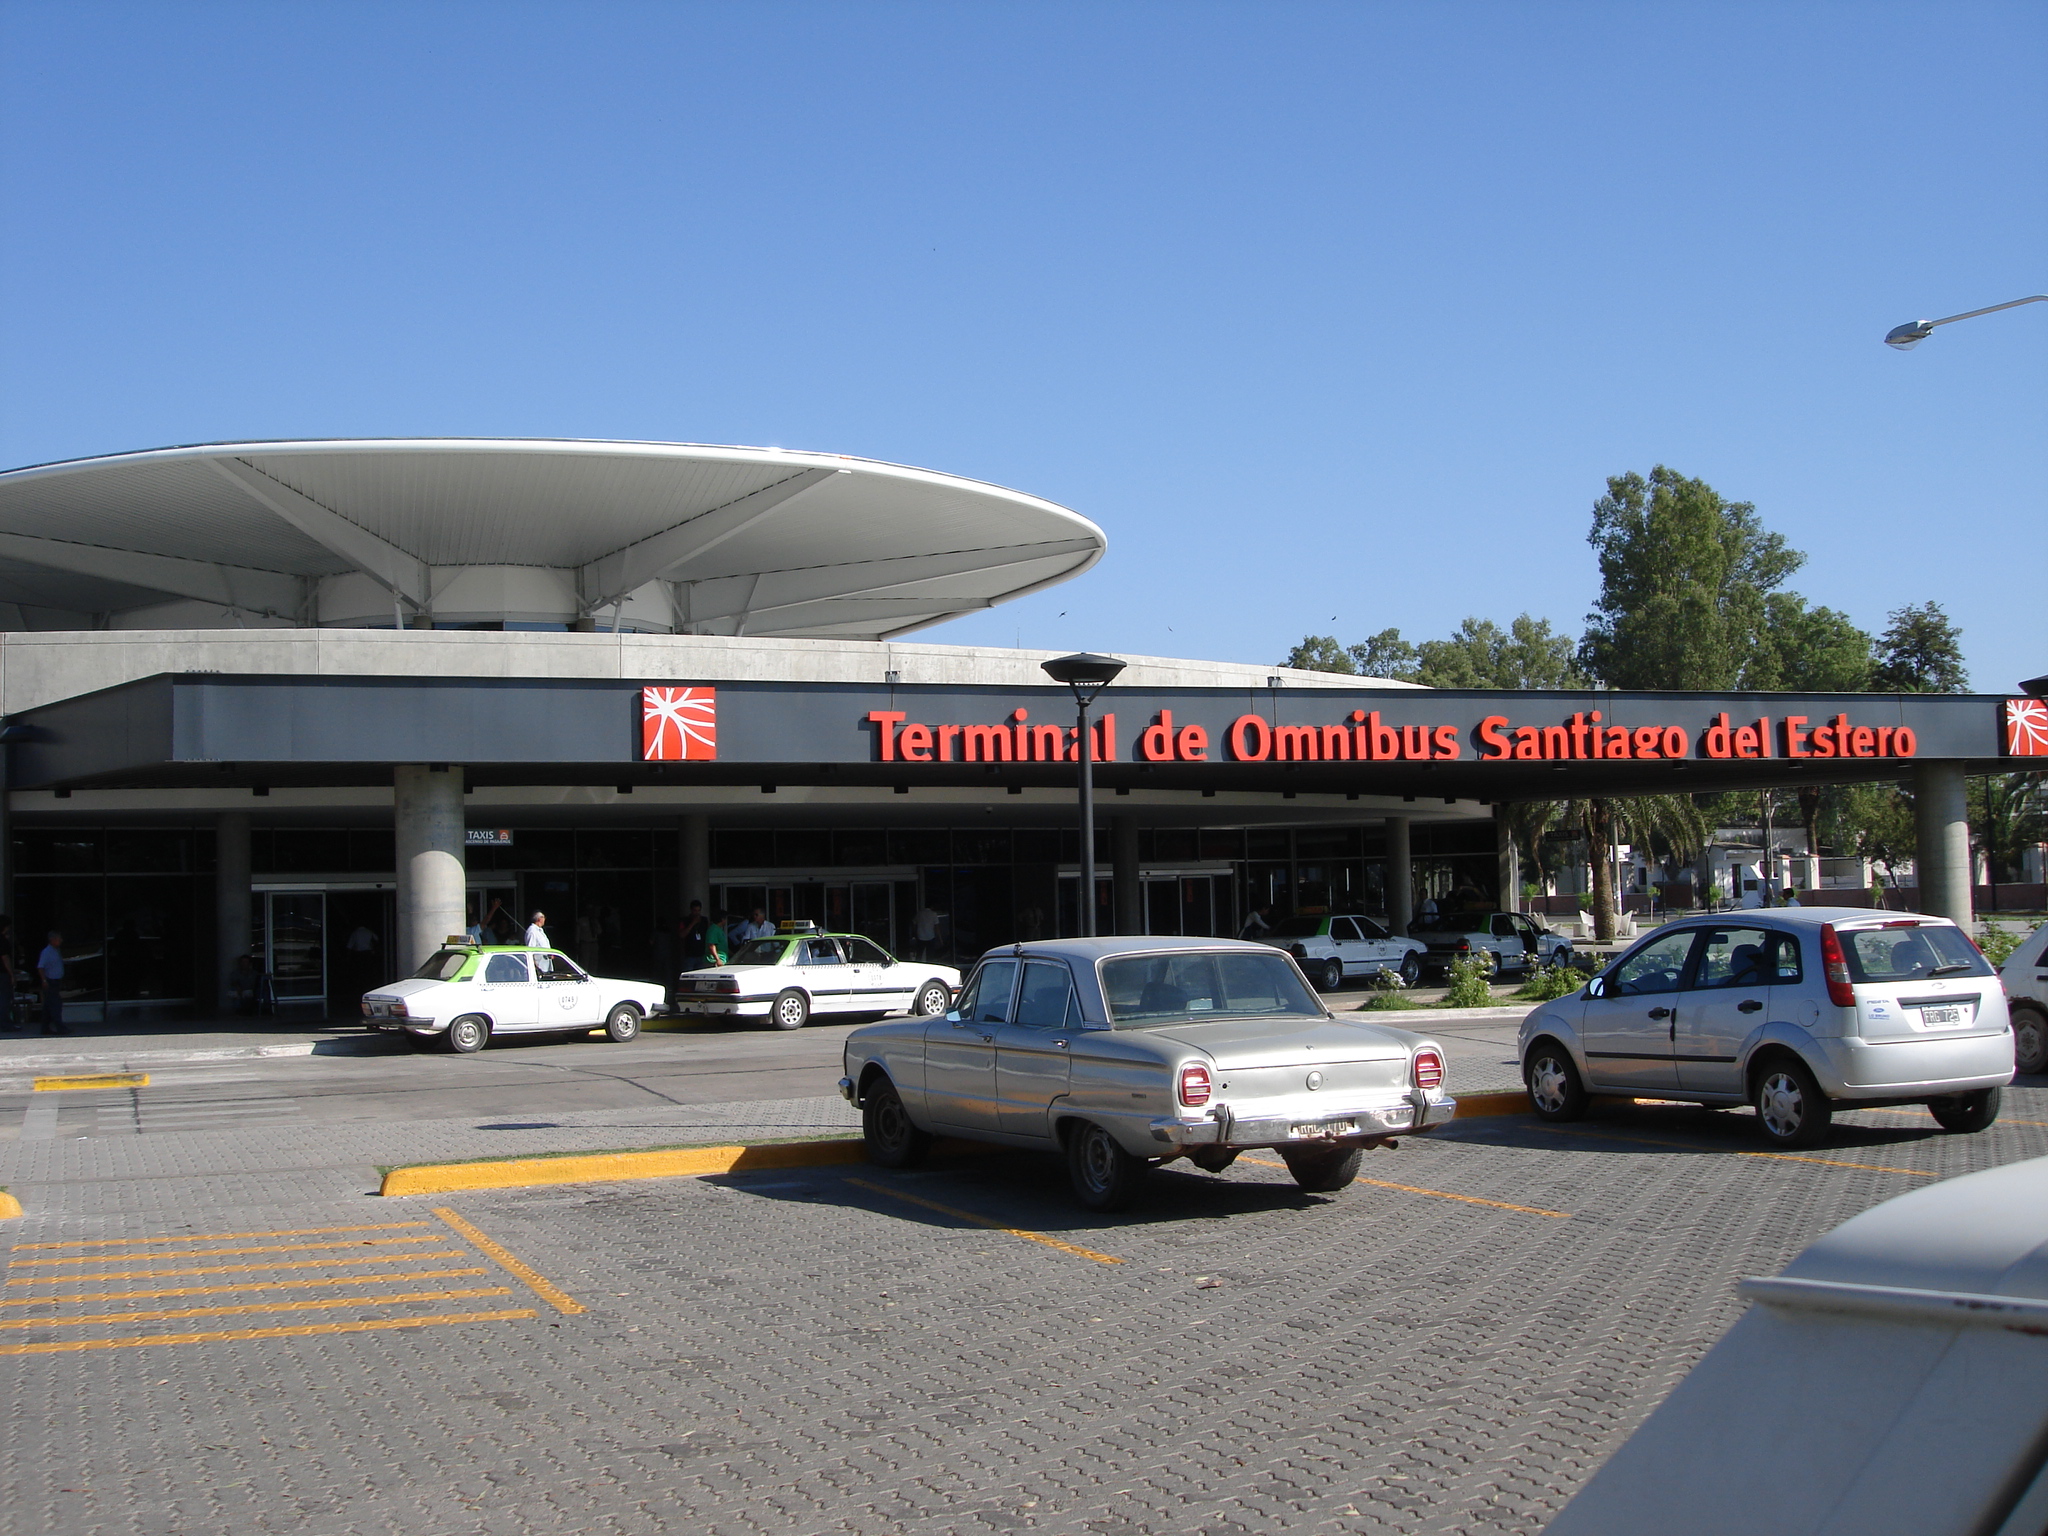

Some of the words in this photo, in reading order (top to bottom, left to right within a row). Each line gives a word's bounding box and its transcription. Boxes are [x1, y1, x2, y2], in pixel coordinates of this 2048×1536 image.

[868, 708, 1116, 761] Terminal
[1143, 709, 1209, 761] de
[1231, 709, 1461, 761] Omnibus
[1479, 710, 1689, 760] Santiago
[1706, 712, 1772, 759] del
[1785, 713, 1917, 758] Estero
[468, 831, 494, 839] TAXIS
[1924, 1010, 1940, 1024] FRG
[1944, 1009, 1960, 1022] 725
